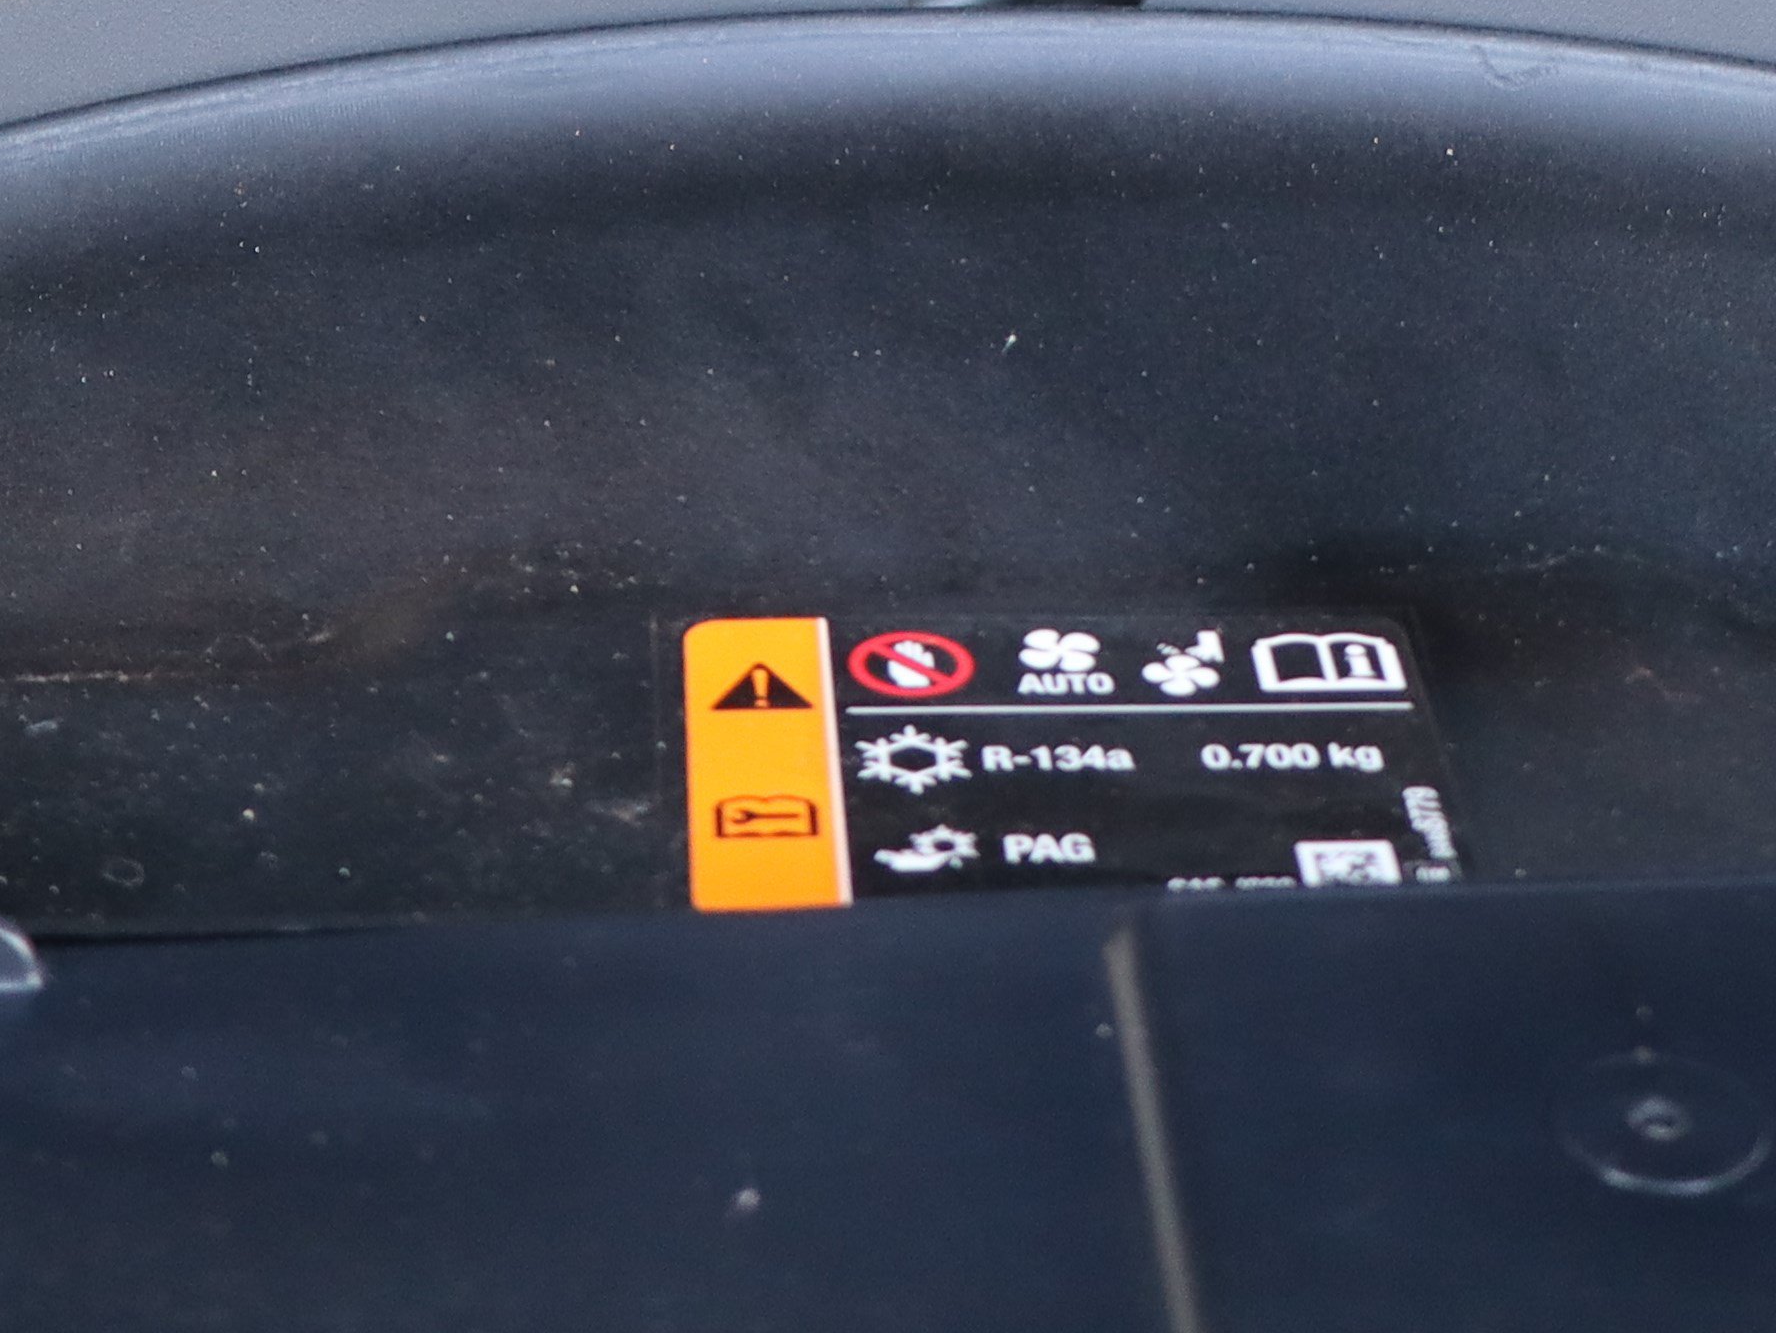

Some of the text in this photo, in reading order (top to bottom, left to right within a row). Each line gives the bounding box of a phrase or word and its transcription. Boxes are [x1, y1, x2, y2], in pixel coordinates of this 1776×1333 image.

[1018, 672, 1116, 696] AUTO
[981, 741, 1385, 773] R-134a 0.700 kg
[1002, 832, 1096, 864] PAG
